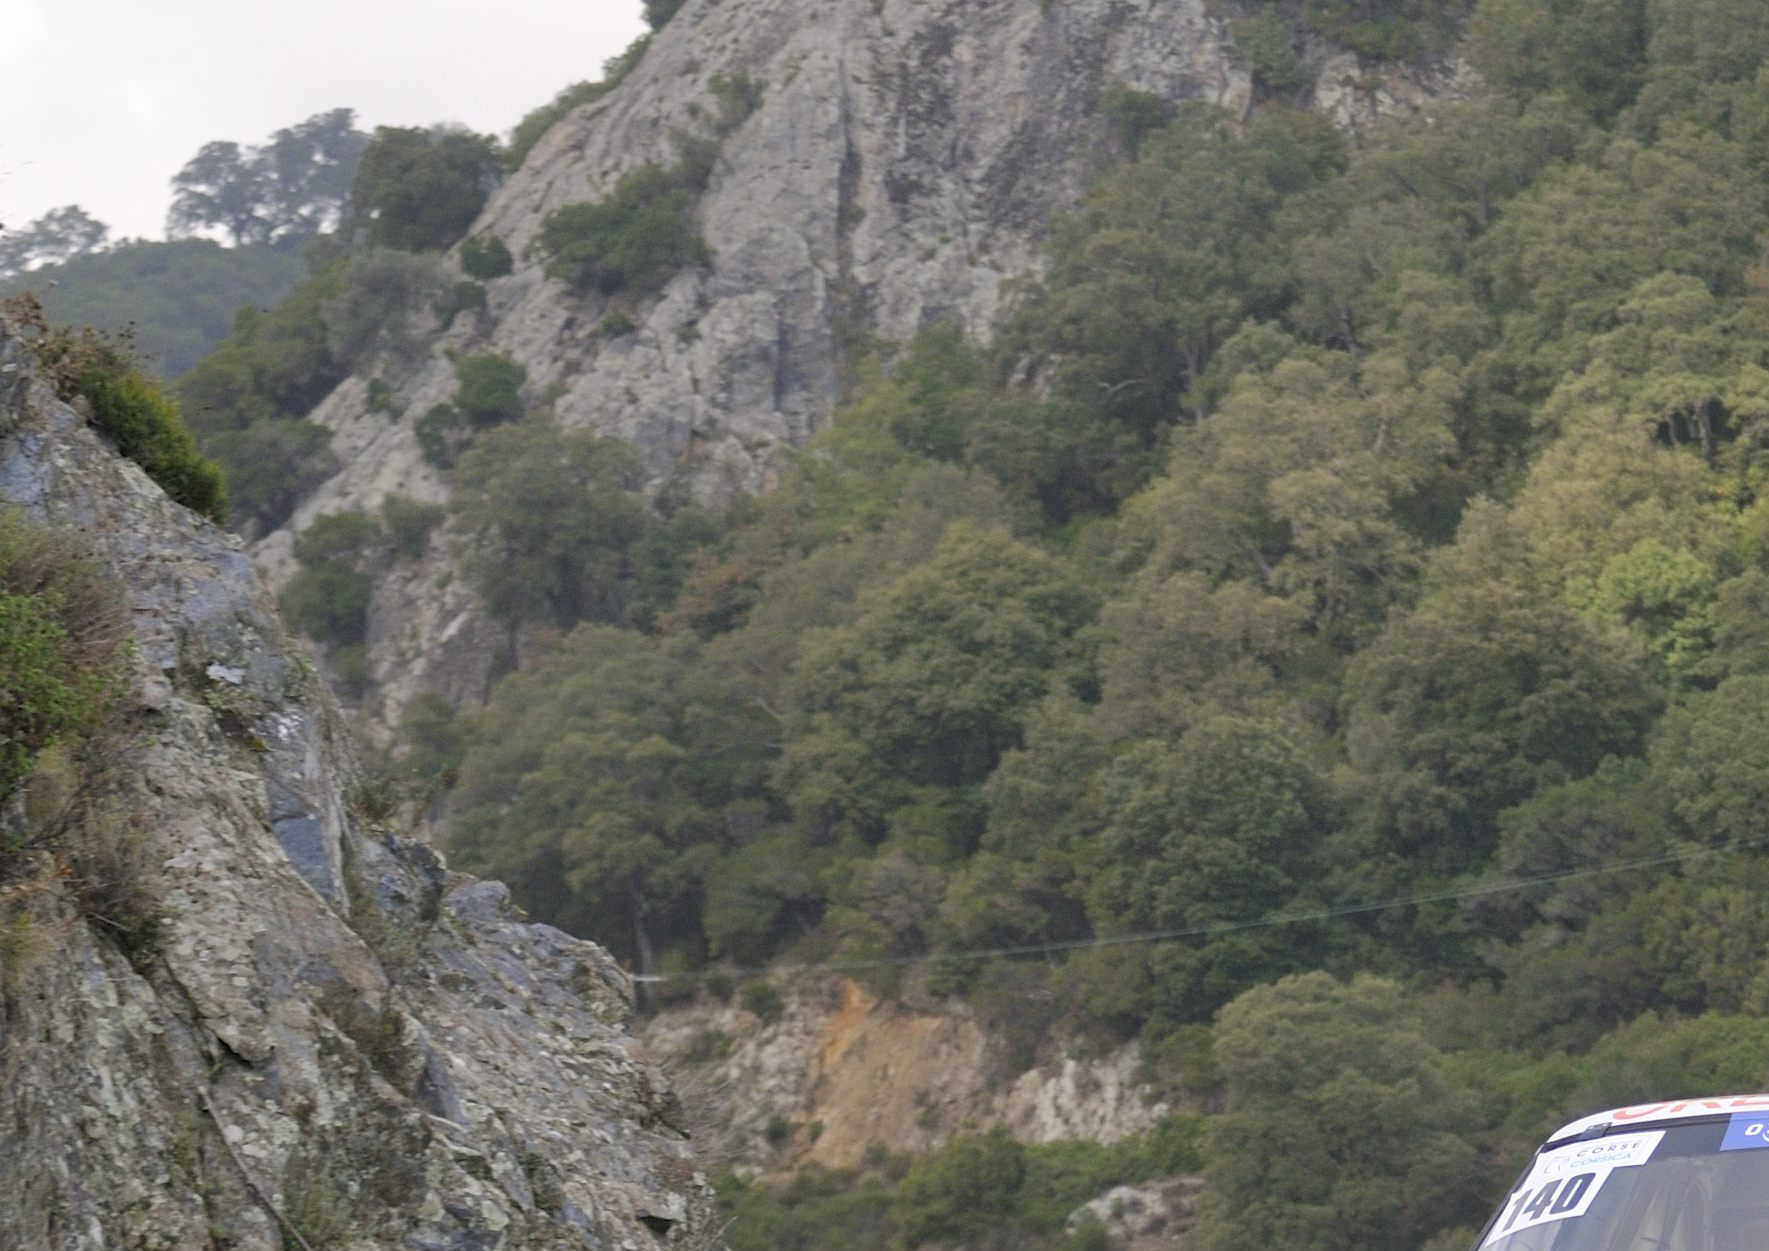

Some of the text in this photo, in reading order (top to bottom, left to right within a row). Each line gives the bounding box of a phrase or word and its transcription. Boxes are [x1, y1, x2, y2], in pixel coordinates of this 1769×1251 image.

[1576, 1142, 1641, 1158] CORSE
[1568, 1152, 1632, 1169] CORSICA
[1502, 1172, 1597, 1233] 140
